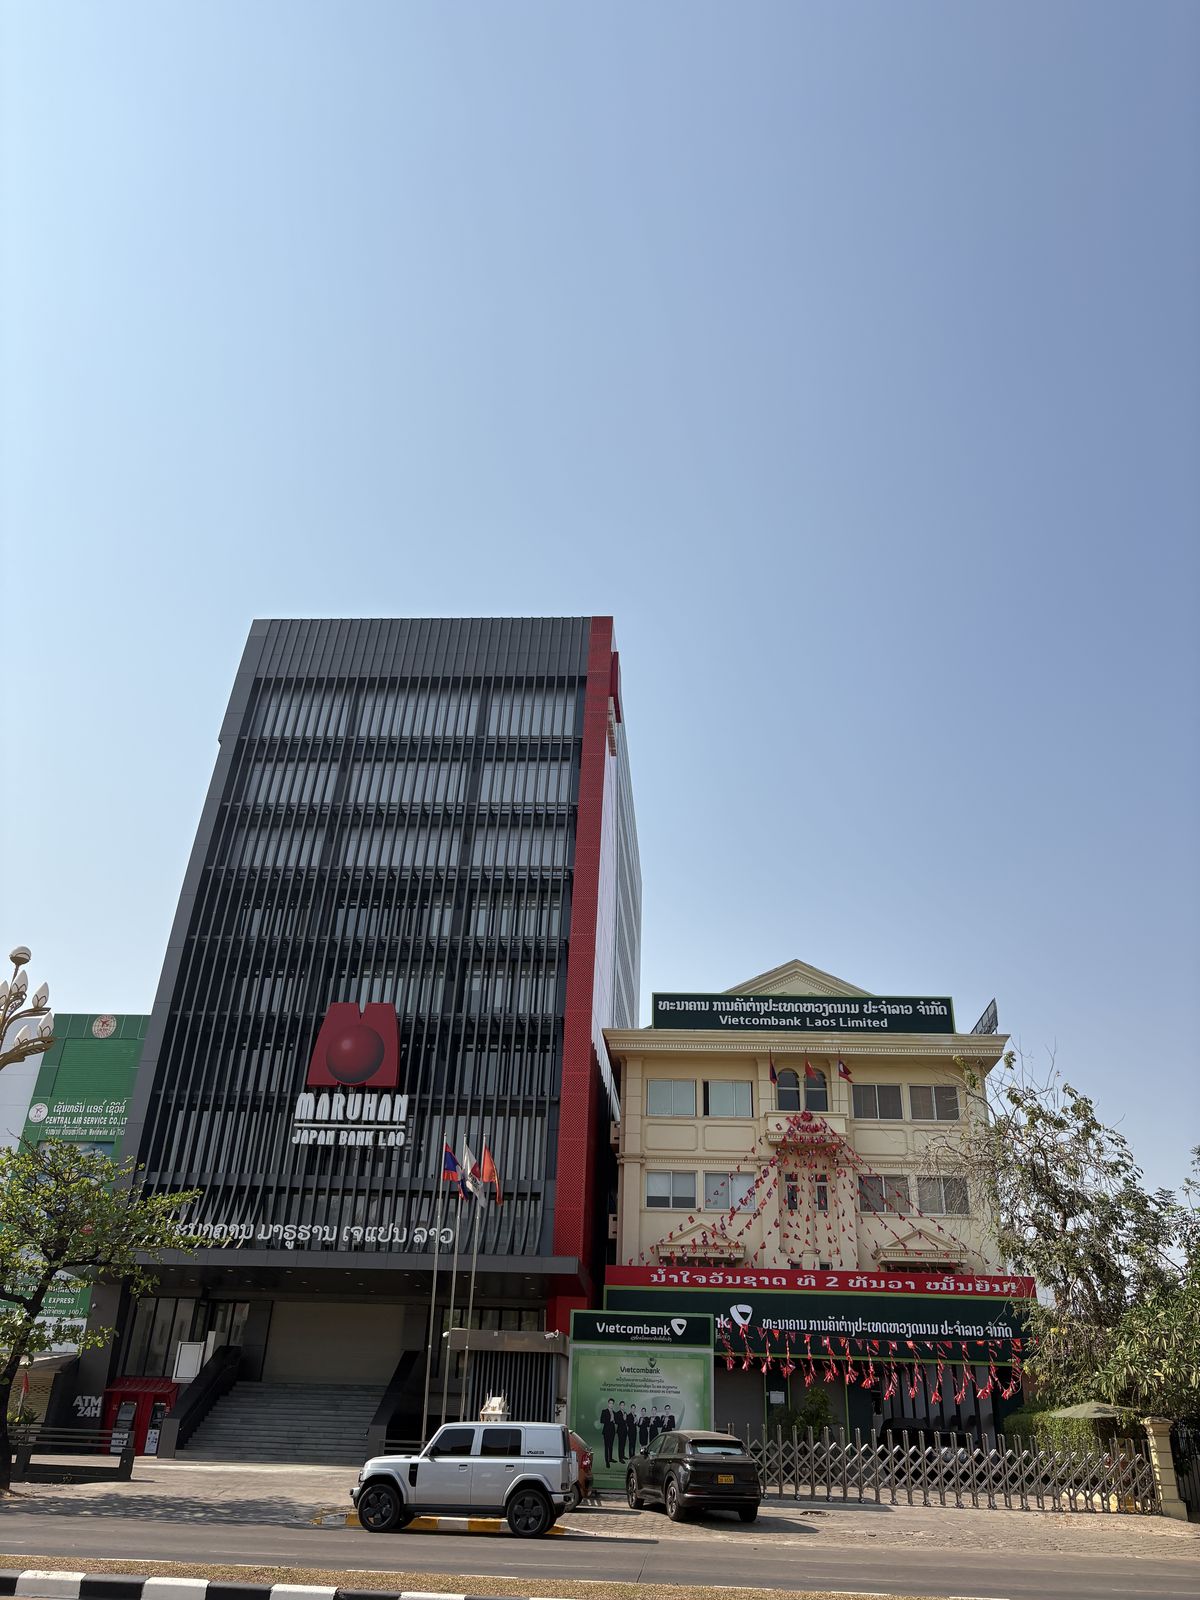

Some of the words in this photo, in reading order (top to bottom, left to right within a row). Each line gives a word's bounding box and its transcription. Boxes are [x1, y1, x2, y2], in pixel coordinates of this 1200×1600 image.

[658, 1000, 709, 1012] ທະນາຄານ
[719, 1015, 801, 1026] Vietcombank
[806, 1017, 836, 1027] Laos
[840, 1017, 888, 1028] Limited
[294, 1093, 409, 1121] MARUHAN
[45, 1116, 71, 1125] CENTRAL
[72, 1116, 82, 1125] AIR
[82, 1116, 108, 1125] SERVICE
[292, 1130, 335, 1145] JAPAN
[339, 1131, 374, 1146] BANK
[378, 1131, 405, 1146] LAO
[826, 1277, 839, 1287] 2
[596, 1322, 671, 1336] Vietcombank
[620, 1366, 660, 1374] Vietcombank
[73, 1396, 103, 1407] ATM
[77, 1407, 101, 1417] 24H
